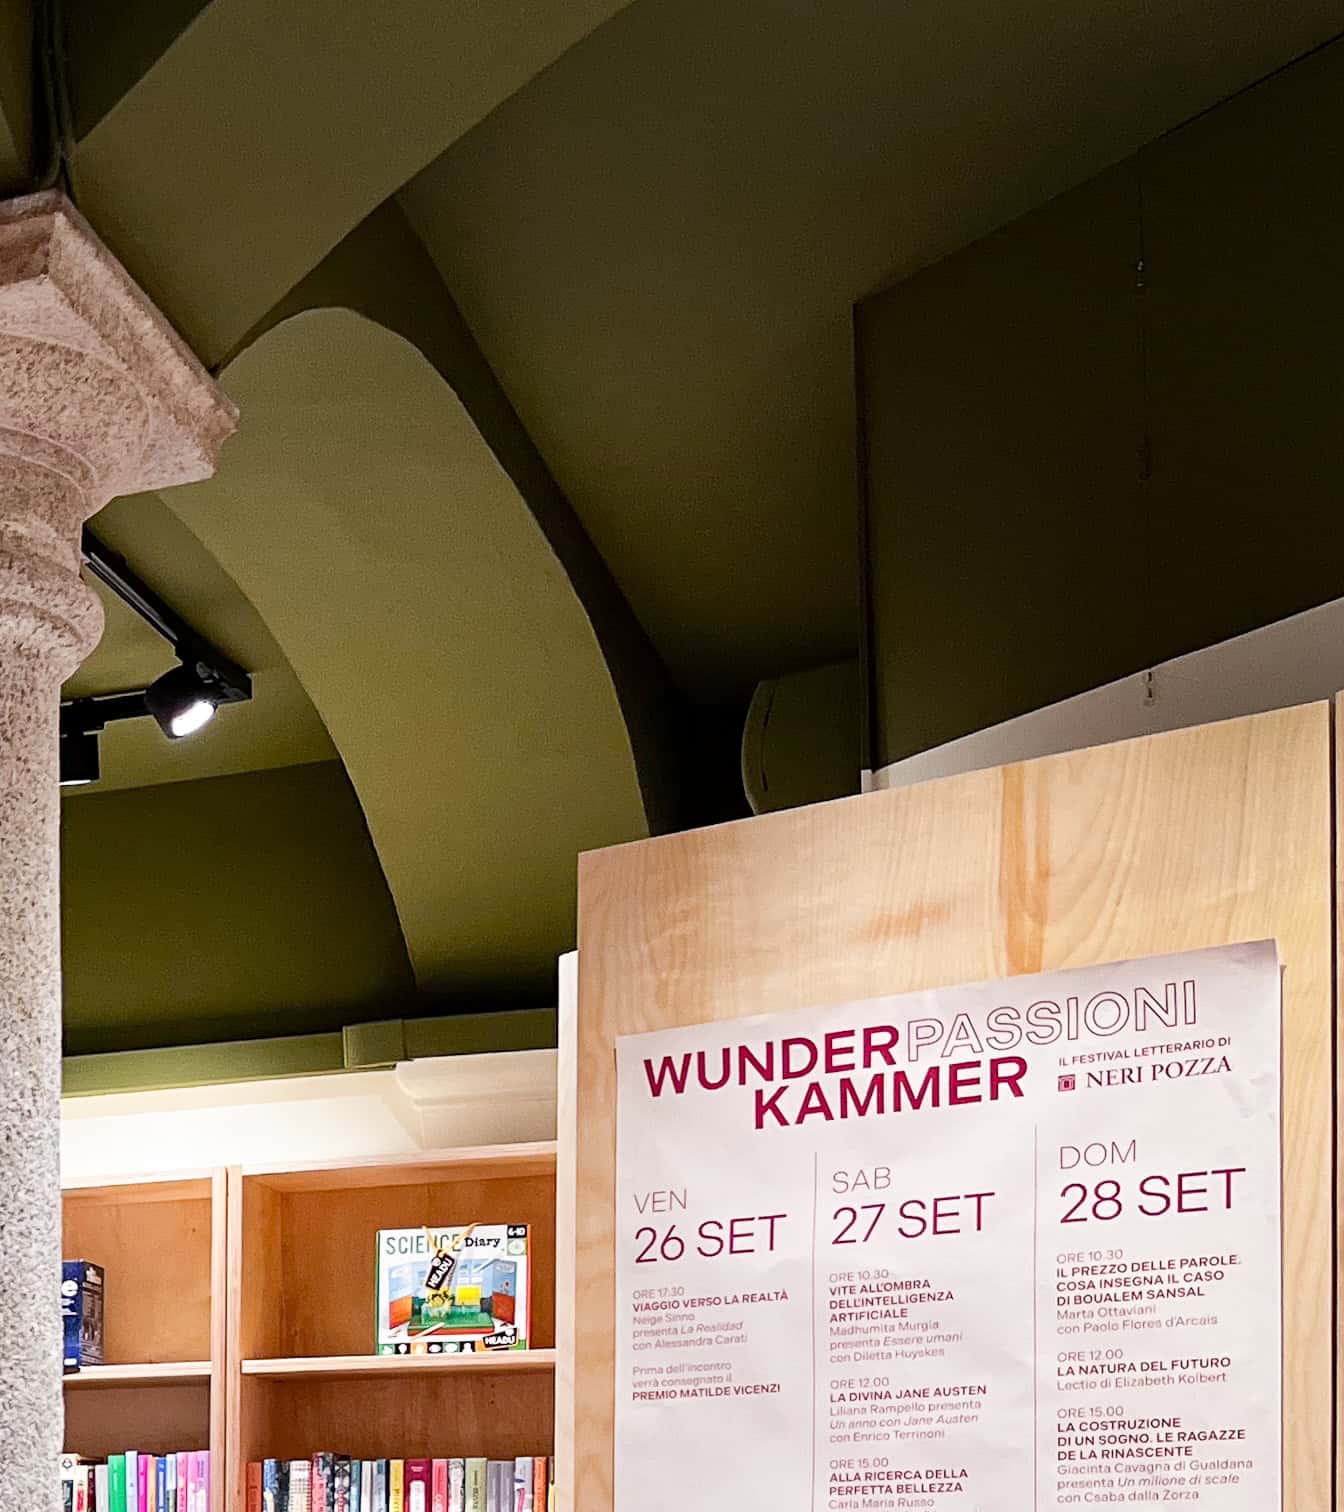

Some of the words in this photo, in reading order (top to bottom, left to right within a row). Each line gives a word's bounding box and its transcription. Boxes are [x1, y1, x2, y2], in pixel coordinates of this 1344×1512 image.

[644, 1024, 900, 1098] WUNDER
[907, 980, 1197, 1062] PASSIONI
[1058, 1055, 1070, 1067] IL
[1072, 1049, 1130, 1066] FESTIVAL
[1133, 1039, 1215, 1059] LETTERARIO
[1218, 1036, 1231, 1048] DI
[1085, 1064, 1146, 1089] NERI
[1150, 1055, 1232, 1082] POZZA
[754, 1056, 1028, 1130] KAMMER
[1059, 1139, 1137, 1171] DOM
[832, 1167, 891, 1195] SAB
[634, 1189, 687, 1215] VEN
[1059, 1179, 1123, 1224] 28
[1136, 1167, 1246, 1215] SET
[832, 1203, 885, 1245] 27
[897, 1192, 995, 1239] SET
[464, 1237, 501, 1248] Diary
[635, 1224, 686, 1264] 26
[697, 1213, 787, 1258] SET
[1056, 1252, 1084, 1264] ORE
[428, 1258, 453, 1289] HEADU
[1056, 1268, 1068, 1278] IL
[1072, 1263, 1128, 1277] PREZZO
[1131, 1259, 1176, 1273] DELLE
[829, 1284, 857, 1297] VITE
[1056, 1280, 1096, 1292] COSA
[1099, 1275, 1162, 1289] INSEGNA
[1168, 1274, 1179, 1284] IL
[1183, 1270, 1225, 1283] CASO
[632, 1300, 680, 1313] VIAGGIO
[682, 1297, 722, 1309] VERSO
[724, 1295, 740, 1306] LA
[742, 1289, 789, 1304] REALTÀ
[1056, 1296, 1070, 1306] DI
[1074, 1290, 1143, 1305] BOUALEM
[1146, 1286, 1205, 1300] SANSAL
[830, 1308, 908, 1323] ARTIFICIALE
[485, 1334, 515, 1346] HEADU
[1057, 1365, 1075, 1377] LA
[1079, 1362, 1137, 1375] NATURA
[1140, 1361, 1167, 1372] DEL
[1171, 1357, 1231, 1371] FUTURO
[632, 1389, 677, 1401] PREMIO
[680, 1386, 731, 1398] MATILDE
[733, 1383, 781, 1396] VICENZI
[830, 1391, 846, 1403] LA
[848, 1390, 892, 1402] DIVINA
[895, 1387, 930, 1399] JANE
[933, 1384, 986, 1397] AUSTEN
[1057, 1422, 1076, 1433] LA
[1079, 1417, 1182, 1432] COSTRUZIONE
[1057, 1437, 1071, 1447] DI
[1074, 1435, 1095, 1446] UN
[1098, 1432, 1153, 1445] SOGNO.
[1156, 1432, 1174, 1443] LE
[1177, 1428, 1246, 1442] RAGAZZE
[1057, 1450, 1076, 1461] DE
[1079, 1449, 1097, 1460] LA
[1101, 1445, 1193, 1459] RINASCENTE
[830, 1472, 862, 1483] ALLA
[864, 1470, 923, 1482] RICERCA
[925, 1468, 968, 1480] DELLA
[829, 1484, 893, 1496] PERFETTA
[896, 1482, 964, 1494] BELLEZZA
